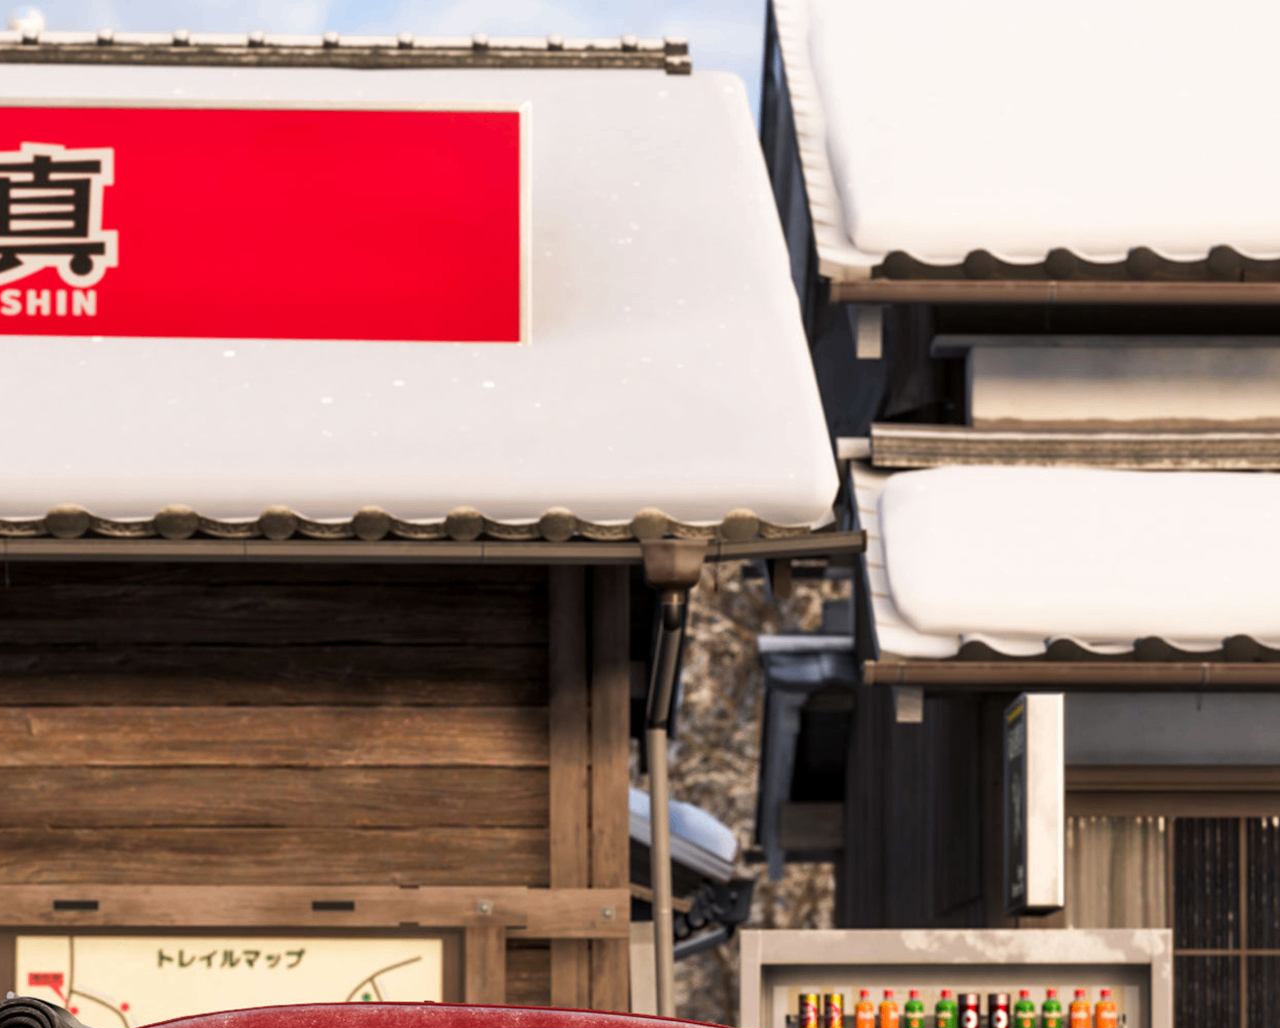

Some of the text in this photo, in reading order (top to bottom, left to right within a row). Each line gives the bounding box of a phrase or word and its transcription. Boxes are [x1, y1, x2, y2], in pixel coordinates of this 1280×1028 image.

[0, 288, 98, 317] SHIN
[157, 948, 306, 969] トレイルマップ
